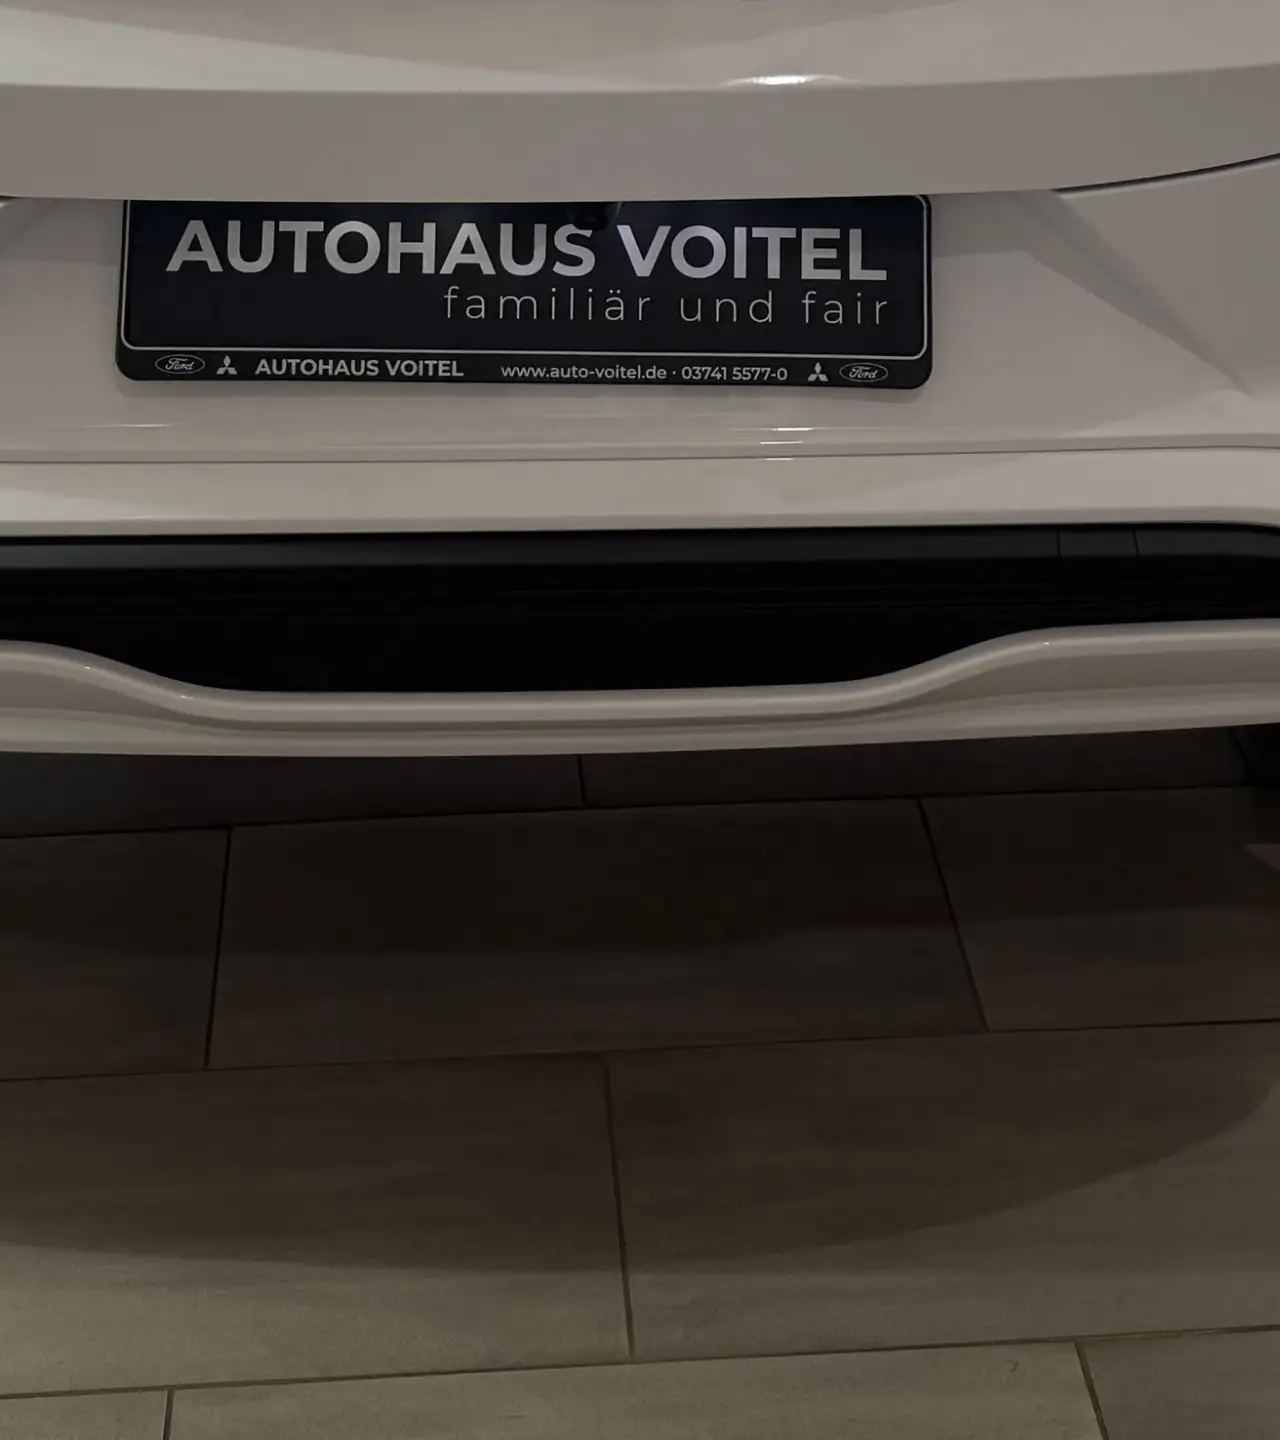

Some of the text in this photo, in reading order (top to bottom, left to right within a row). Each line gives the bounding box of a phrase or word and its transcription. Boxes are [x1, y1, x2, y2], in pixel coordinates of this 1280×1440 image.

[165, 218, 888, 283] AUTOHAUS VOITEL
[443, 285, 889, 326] familiär und fair
[255, 359, 464, 377] AUTOHAUS VOITEL
[500, 363, 668, 380] www.auto-voitel.de
[681, 366, 727, 381] 03741
[732, 367, 788, 381] 5577-0
